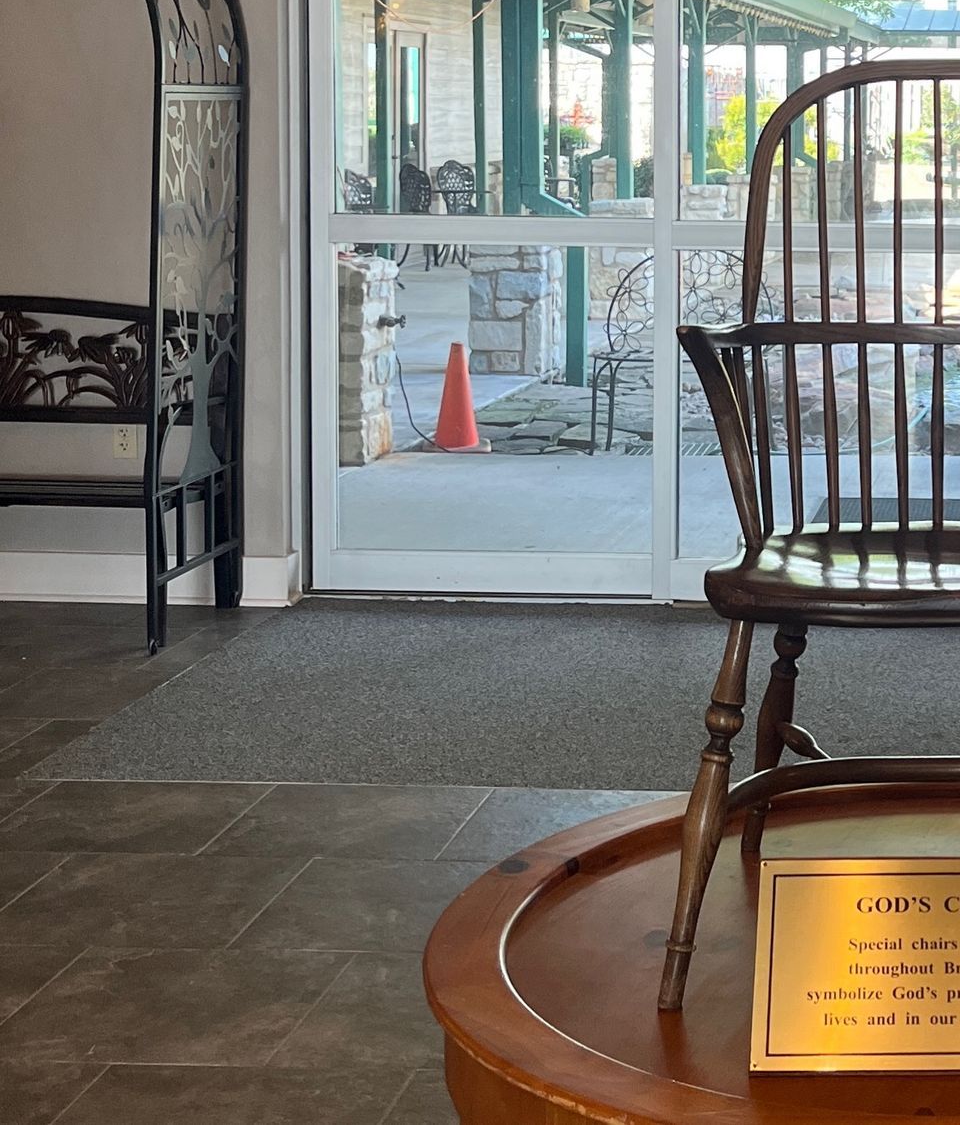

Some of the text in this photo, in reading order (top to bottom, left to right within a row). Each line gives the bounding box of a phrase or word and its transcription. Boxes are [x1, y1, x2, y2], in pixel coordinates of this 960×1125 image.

[856, 895, 932, 914] GOD'S
[848, 937, 903, 952] Special
[911, 937, 958, 951] chairs
[849, 962, 934, 978] throughout
[806, 987, 883, 1004] symbolize
[892, 987, 938, 1001] God's
[824, 1012, 858, 1026] lives
[867, 1012, 896, 1026] and
[905, 1012, 921, 1026] in
[929, 1014, 958, 1026] our
